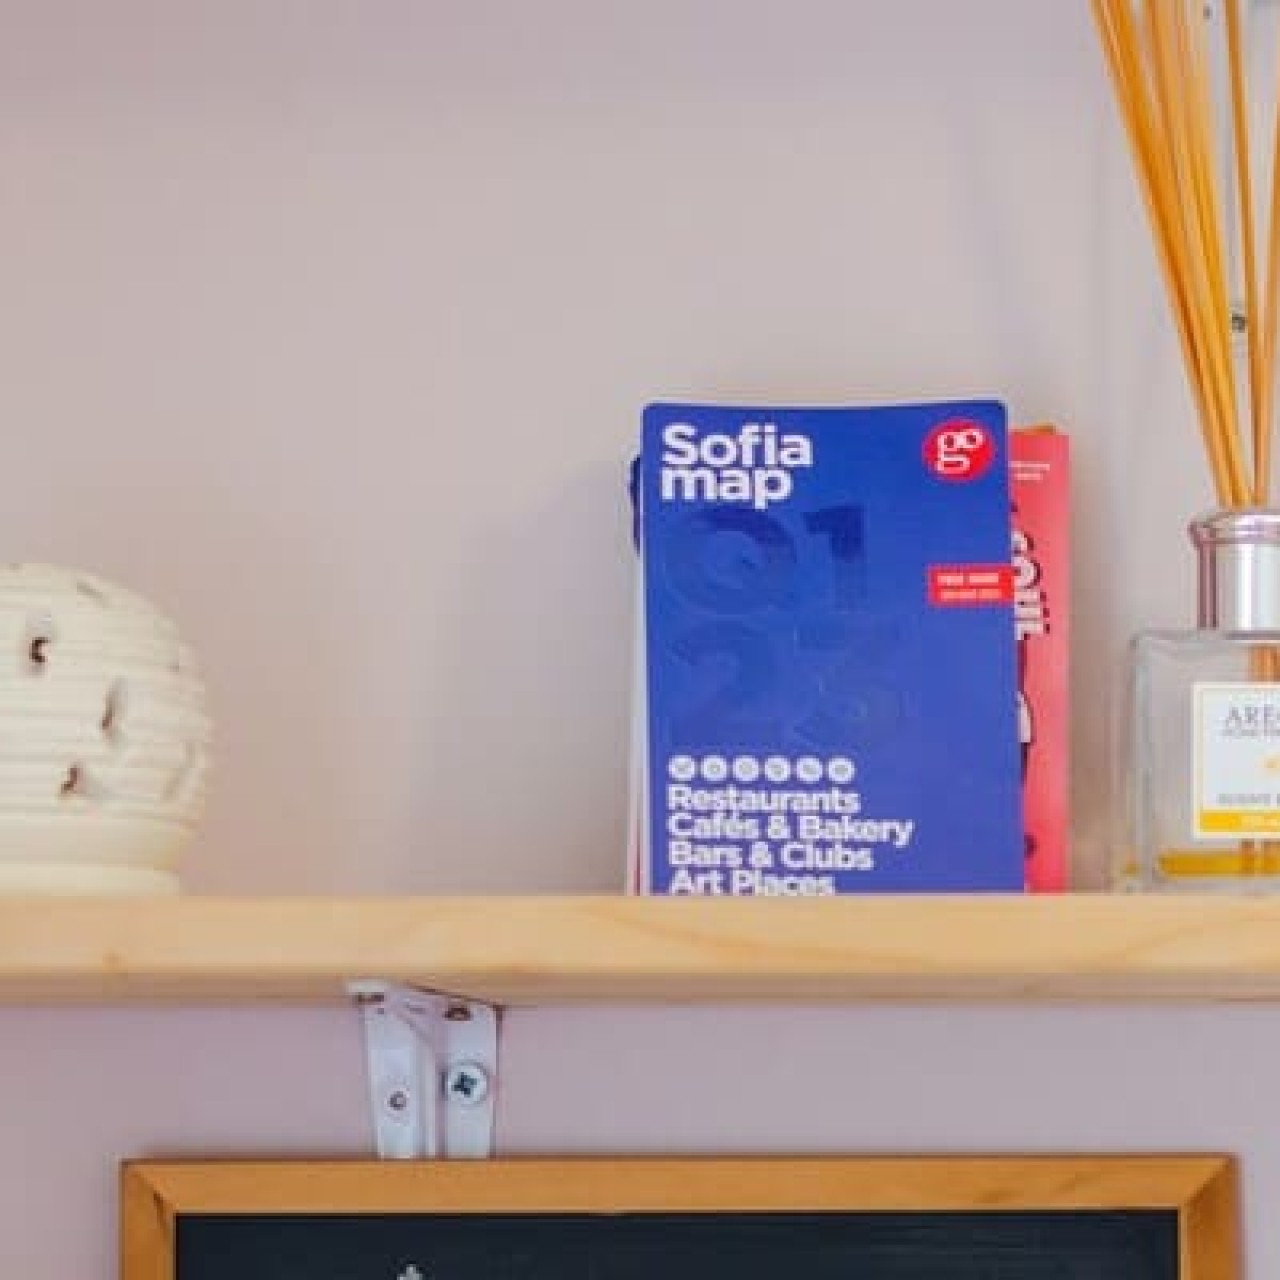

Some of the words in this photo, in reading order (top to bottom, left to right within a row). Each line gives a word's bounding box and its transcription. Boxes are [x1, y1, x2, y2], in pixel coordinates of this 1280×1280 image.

[660, 423, 813, 467] Sofia
[937, 429, 983, 472] go
[660, 468, 793, 510] map
[667, 784, 861, 813] Restaurants
[667, 810, 760, 839] Cafés
[767, 815, 790, 840] &
[799, 815, 915, 848] Bakery
[669, 840, 744, 868] Bars
[748, 841, 772, 868] &
[781, 841, 874, 870] Clubs
[670, 870, 723, 895] Art
[731, 870, 836, 895] Places
